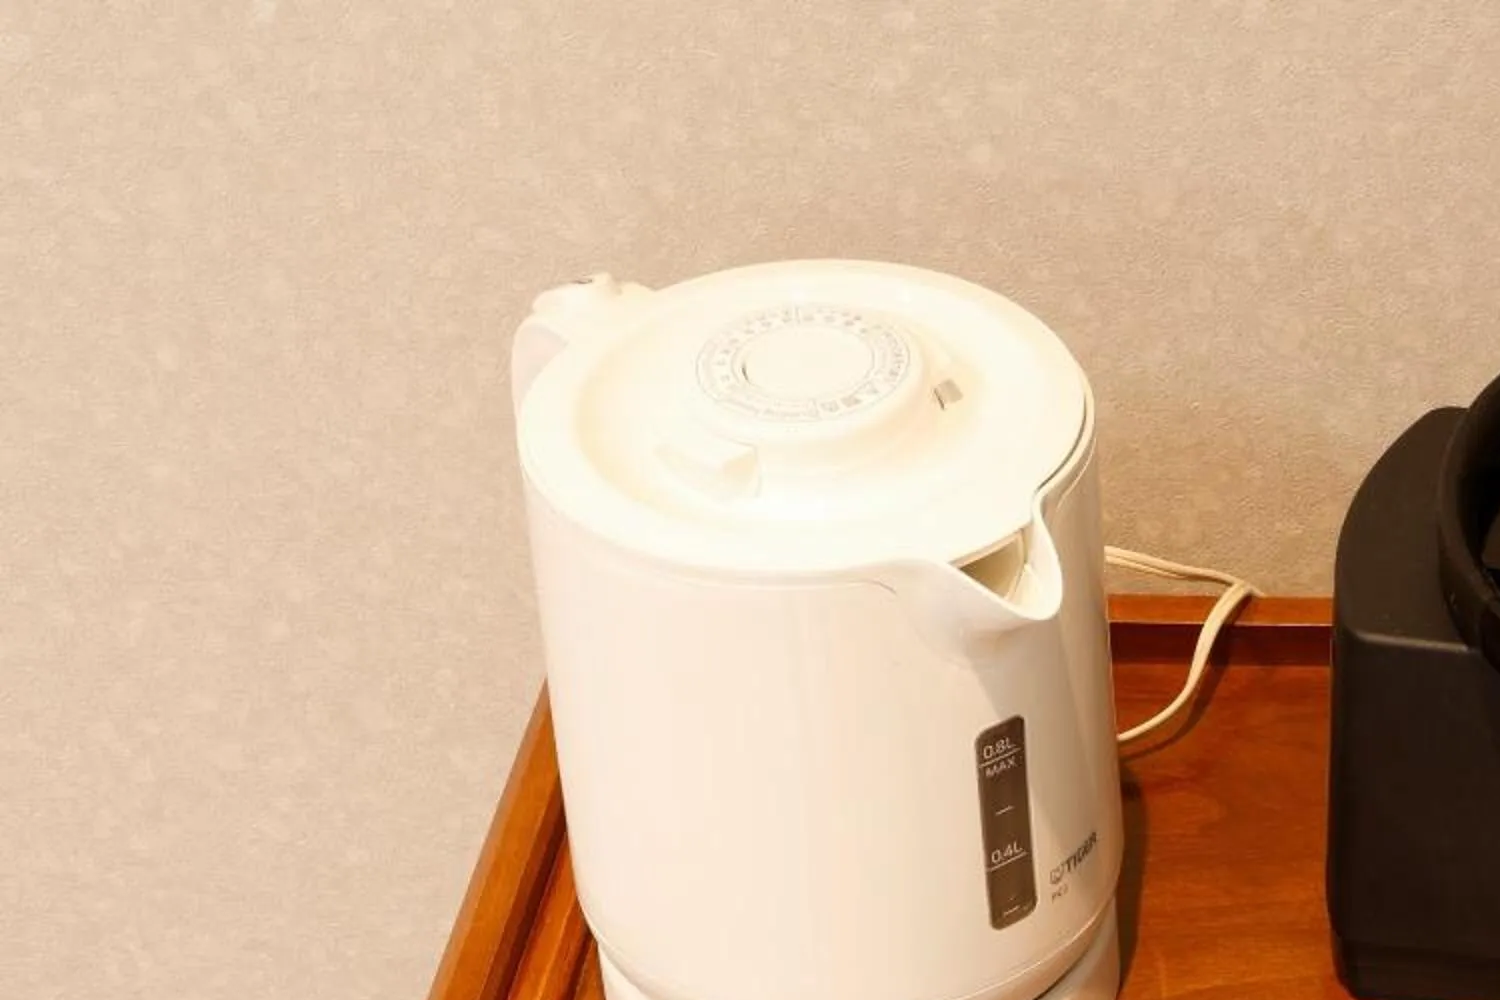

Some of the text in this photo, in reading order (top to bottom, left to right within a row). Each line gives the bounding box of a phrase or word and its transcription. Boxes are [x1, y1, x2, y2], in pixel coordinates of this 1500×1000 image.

[983, 736, 1017, 759] 0.8L
[985, 755, 1018, 777] MAX
[991, 840, 1024, 864] 0.4L
[1064, 831, 1098, 873] TIGER
